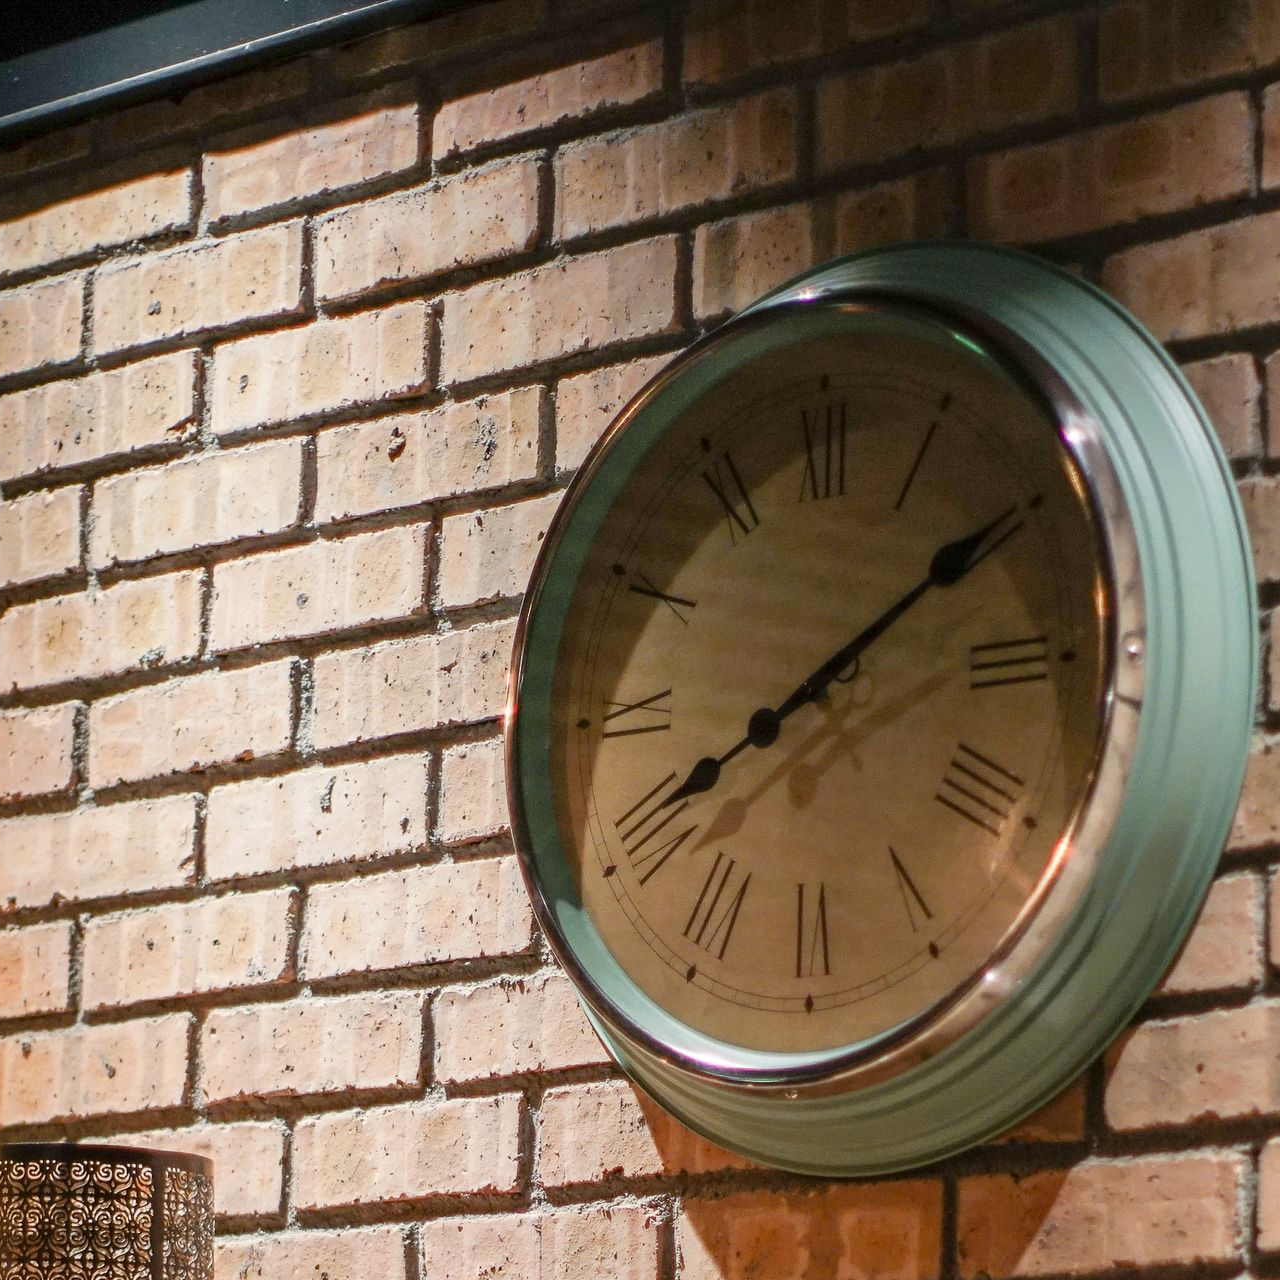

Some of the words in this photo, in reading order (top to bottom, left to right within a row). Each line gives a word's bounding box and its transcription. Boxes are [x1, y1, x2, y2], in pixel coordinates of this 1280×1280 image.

[700, 447, 761, 547] XI
[797, 401, 849, 504] XII
[628, 571, 698, 626] X
[968, 634, 1049, 691] III
[601, 688, 673, 740] IX
[612, 767, 699, 891] VIII
[934, 742, 1026, 839] IIII
[681, 851, 754, 963] VII
[794, 880, 832, 980] VI
[887, 842, 934, 934] V
